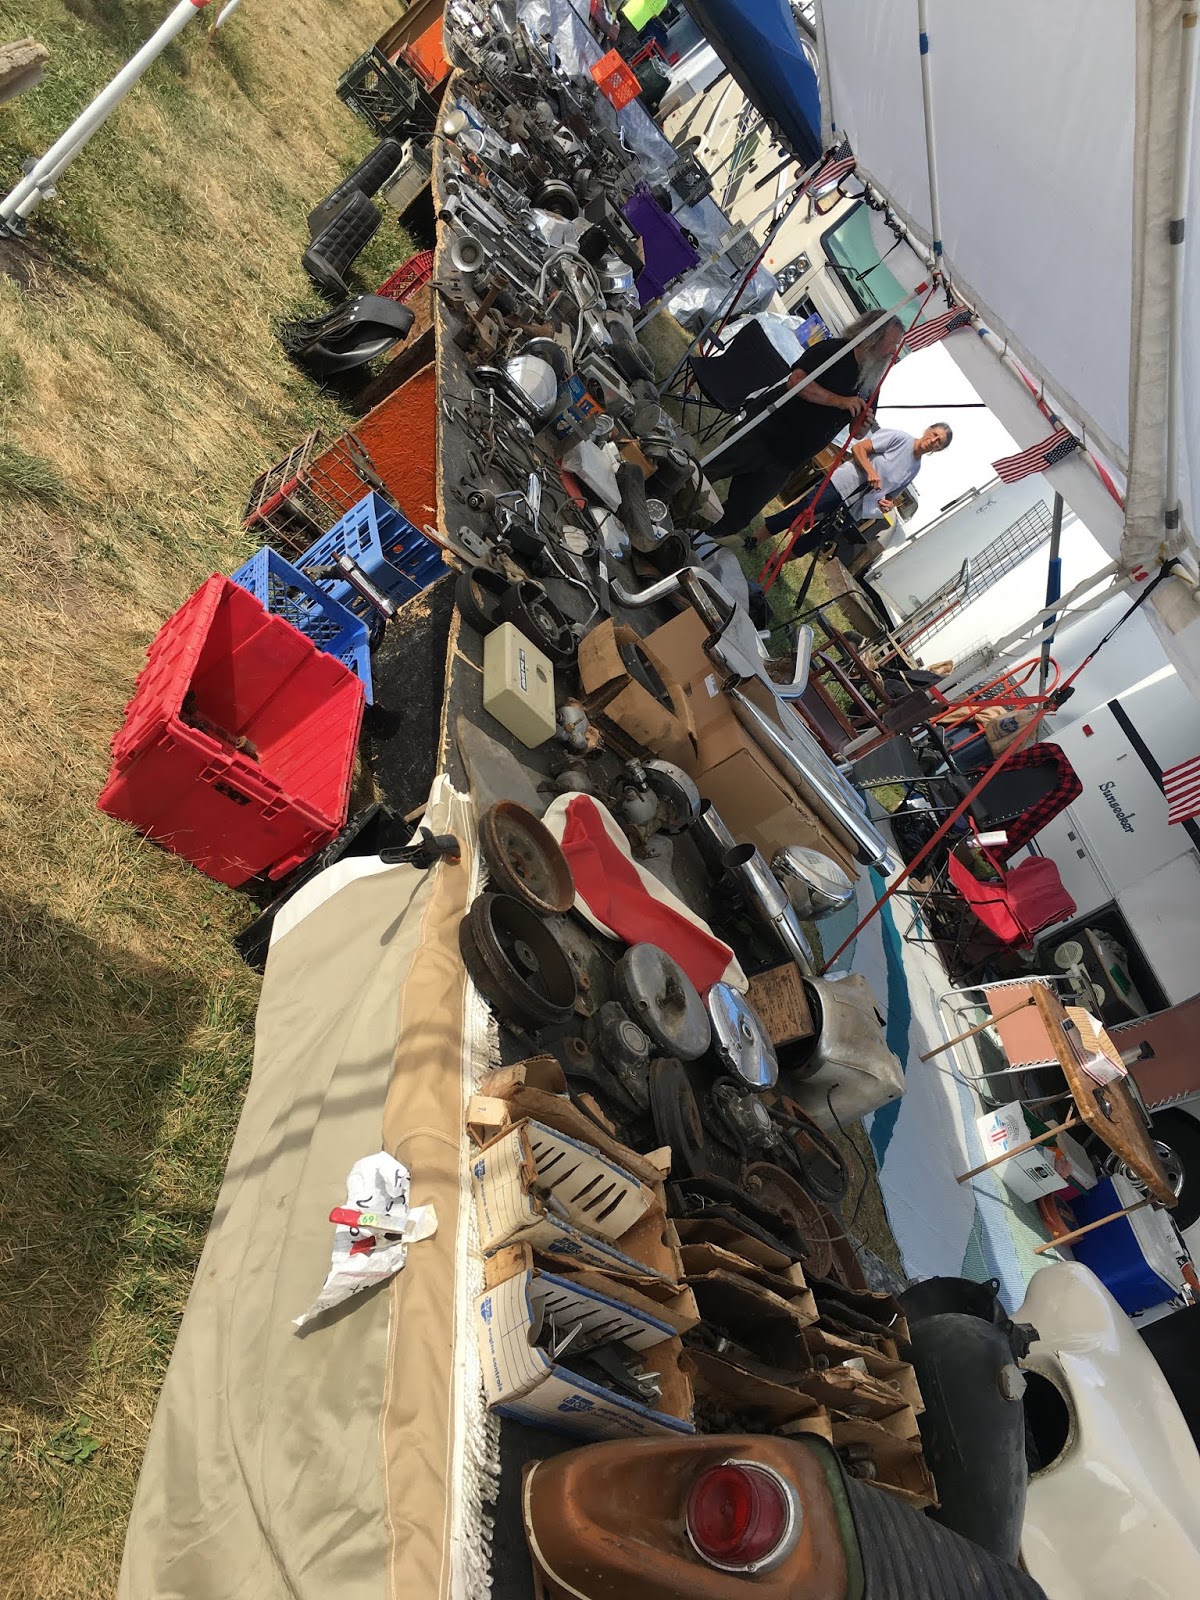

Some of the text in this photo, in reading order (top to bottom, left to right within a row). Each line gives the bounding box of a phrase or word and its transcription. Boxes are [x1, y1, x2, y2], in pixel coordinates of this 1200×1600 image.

[1098, 781, 1136, 833] Sunseeker
[488, 1327, 496, 1355] engine
[492, 1357, 503, 1392] controls
